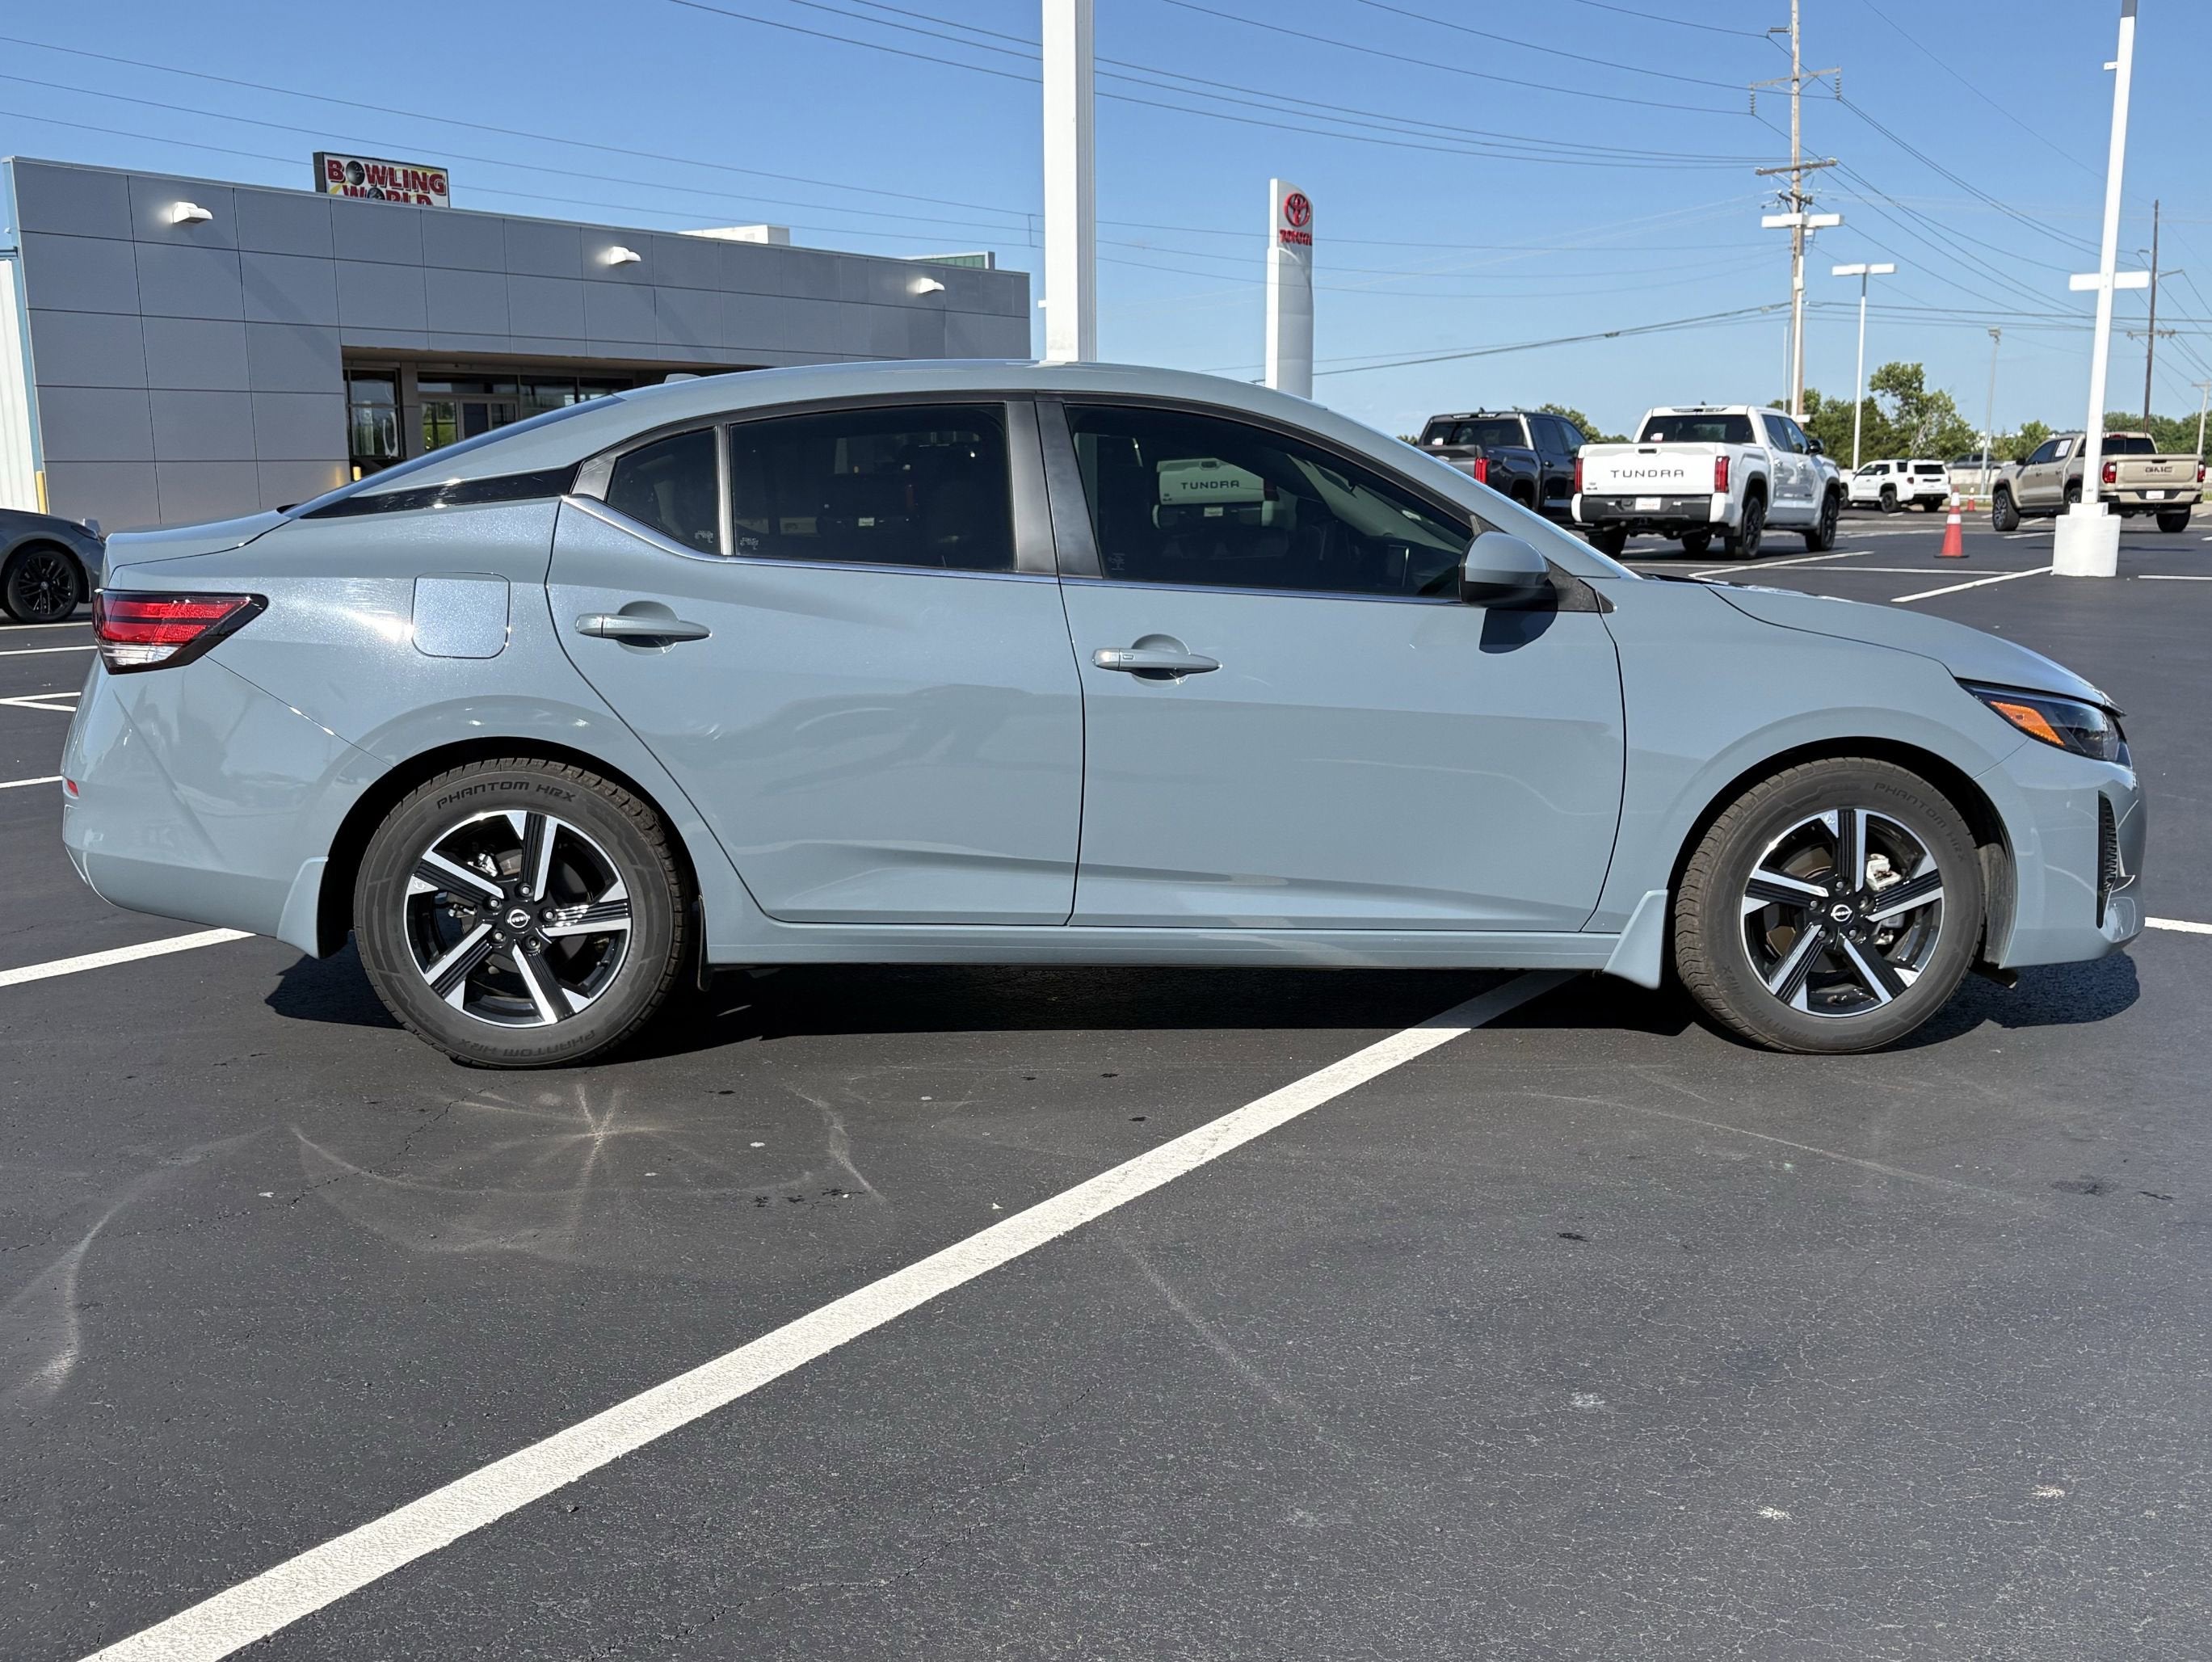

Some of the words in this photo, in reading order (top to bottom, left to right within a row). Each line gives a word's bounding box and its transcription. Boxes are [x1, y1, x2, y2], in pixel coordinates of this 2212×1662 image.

[327, 159, 446, 195] BOWLING
[1181, 480, 1239, 490] TUNDRA
[1610, 469, 1684, 478] TUNDRA
[436, 781, 530, 810] PHANTOM
[536, 783, 577, 802] HRX
[1873, 781, 1949, 830] PHANTOM
